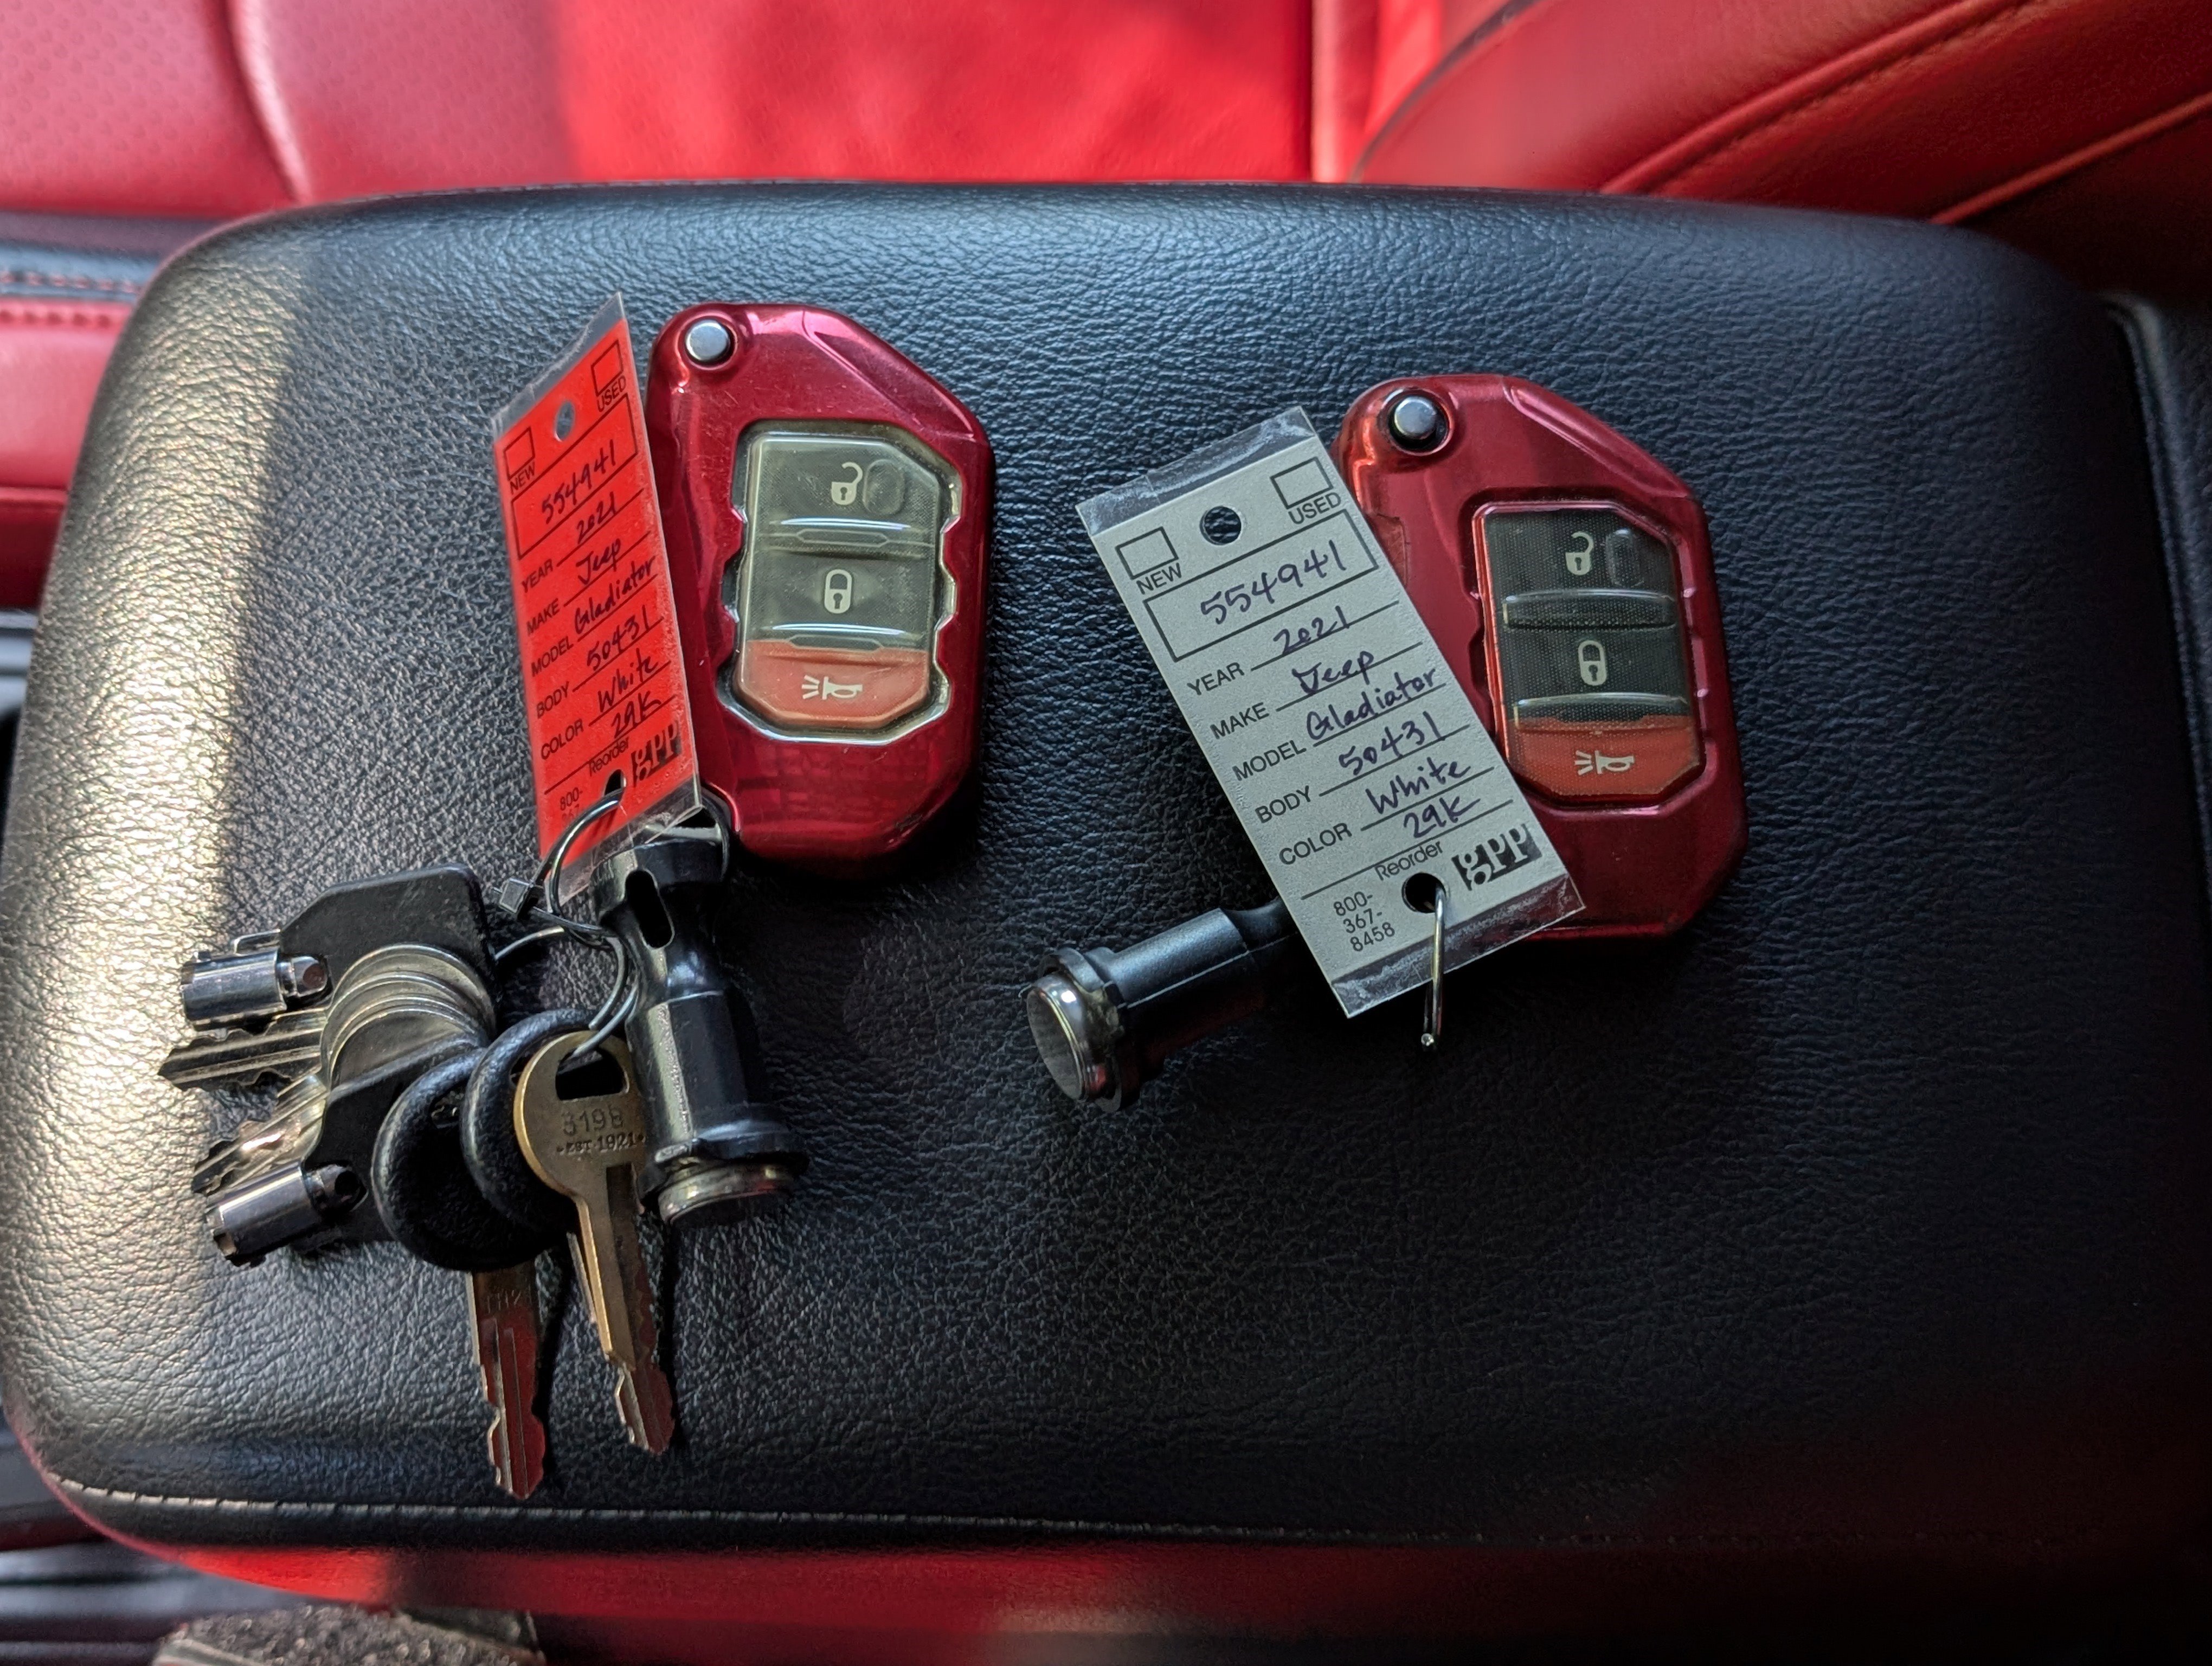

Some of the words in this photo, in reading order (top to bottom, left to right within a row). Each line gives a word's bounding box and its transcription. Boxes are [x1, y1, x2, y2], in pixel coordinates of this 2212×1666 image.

[597, 375, 627, 413] USED
[509, 462, 536, 495] NEW
[542, 439, 616, 524] 554941
[1288, 492, 1342, 524] USED
[521, 559, 554, 593] YEAR
[576, 491, 616, 544] 2021
[1136, 562, 1182, 595] NEW
[1200, 540, 1347, 625] 554941
[526, 598, 561, 635] MAKE
[576, 538, 621, 585] Jeep
[531, 636, 574, 677] MODEL
[574, 556, 655, 635] Gladiator
[536, 681, 570, 719] BODY
[586, 604, 651, 671] 50431
[1187, 662, 1244, 696] YEAR
[1273, 605, 1350, 656] 2021
[541, 719, 584, 760] COLOR
[597, 648, 659, 713] White
[1210, 702, 1270, 740] MAKE
[1291, 650, 1374, 695] Jeep
[1232, 740, 1307, 781] MODEL
[1306, 669, 1436, 740] Gladiator
[560, 786, 583, 811] 800-
[588, 736, 629, 777] Reorder
[1255, 786, 1313, 824] BODY
[1338, 711, 1445, 775] 50431
[1279, 822, 1353, 865] COLOR
[1365, 757, 1471, 814] White
[1374, 841, 1443, 881] Reorder
[1333, 891, 1373, 917] 800-
[1343, 908, 1382, 934] 367-
[1350, 922, 1396, 952] 8458
